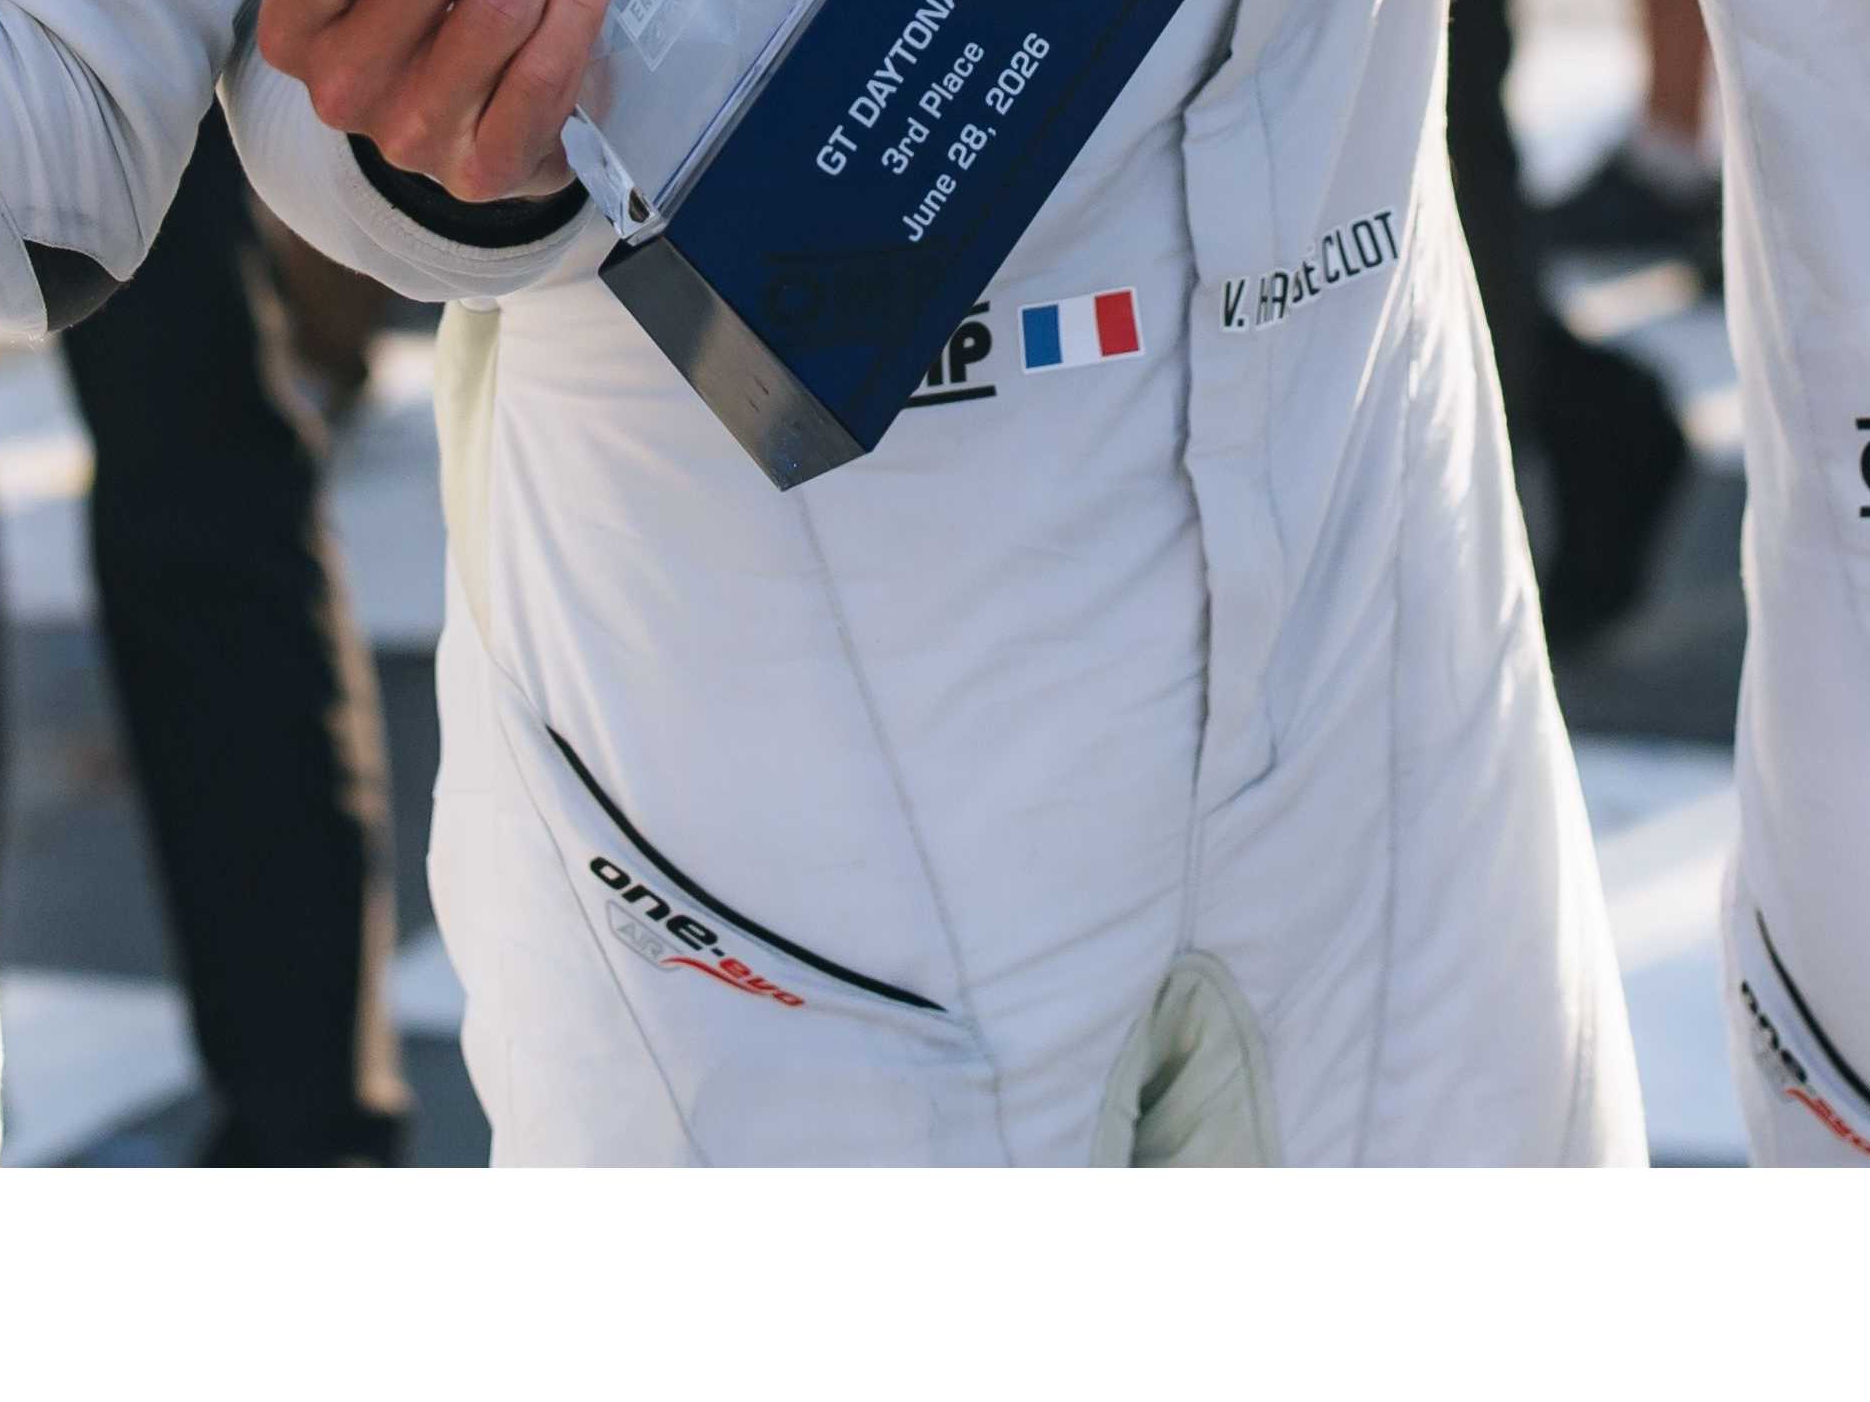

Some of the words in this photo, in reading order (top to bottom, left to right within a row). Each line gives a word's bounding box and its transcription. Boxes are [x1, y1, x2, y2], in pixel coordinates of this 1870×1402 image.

[815, 124, 858, 176] GT
[881, 117, 930, 175] 3rd
[918, 42, 985, 120] Place
[902, 172, 957, 243] June
[947, 122, 997, 171] 28,
[985, 32, 1050, 116] 2026
[1223, 278, 1246, 328] V.
